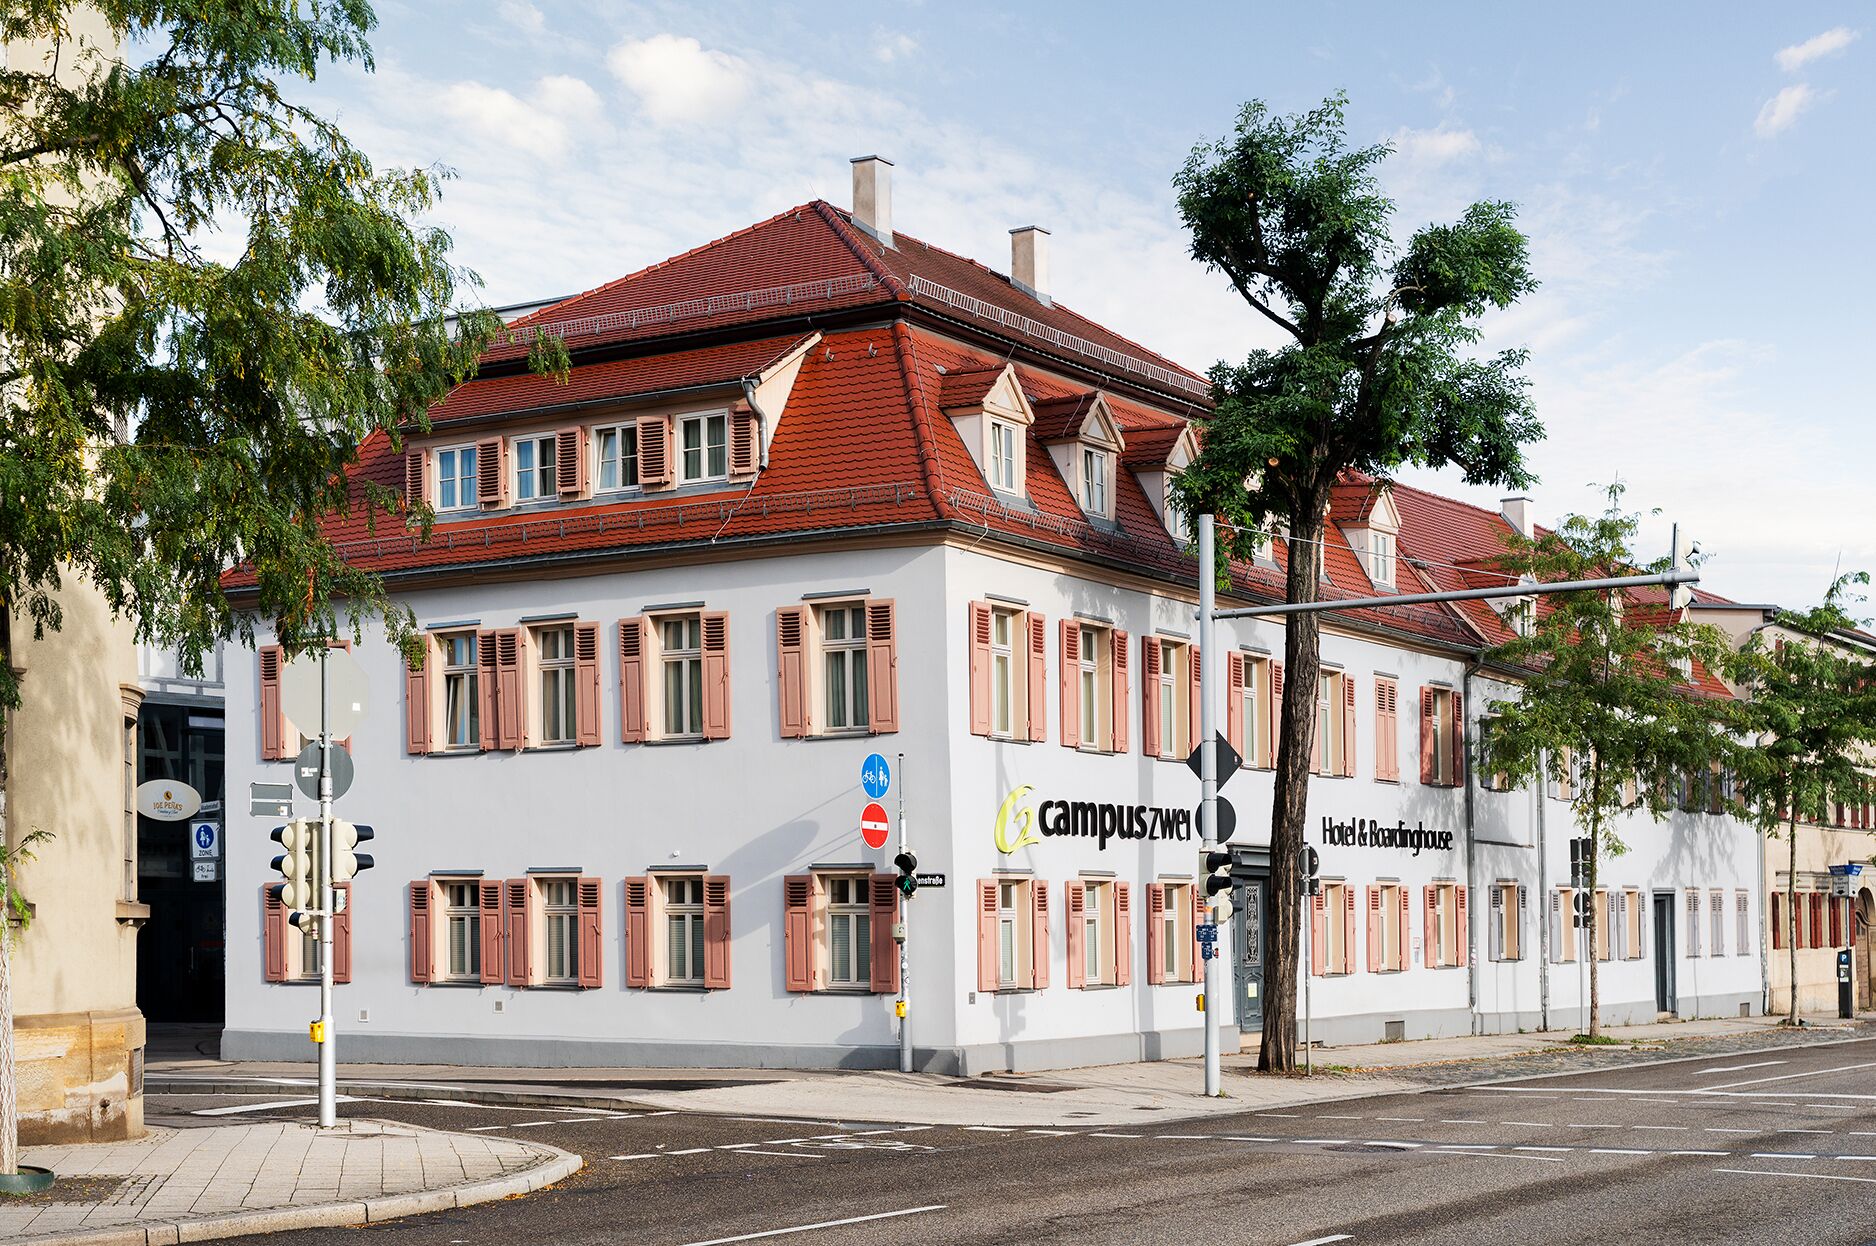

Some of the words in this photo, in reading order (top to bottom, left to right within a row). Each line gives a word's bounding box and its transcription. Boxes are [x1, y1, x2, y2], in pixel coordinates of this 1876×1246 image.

[153, 802, 163, 810] JOE
[1322, 816, 1356, 847] Hotel
[1357, 818, 1368, 847] &
[1369, 819, 1453, 857] Boardinghouse
[198, 849, 213, 857] ZONE
[917, 875, 943, 885] enstraße
